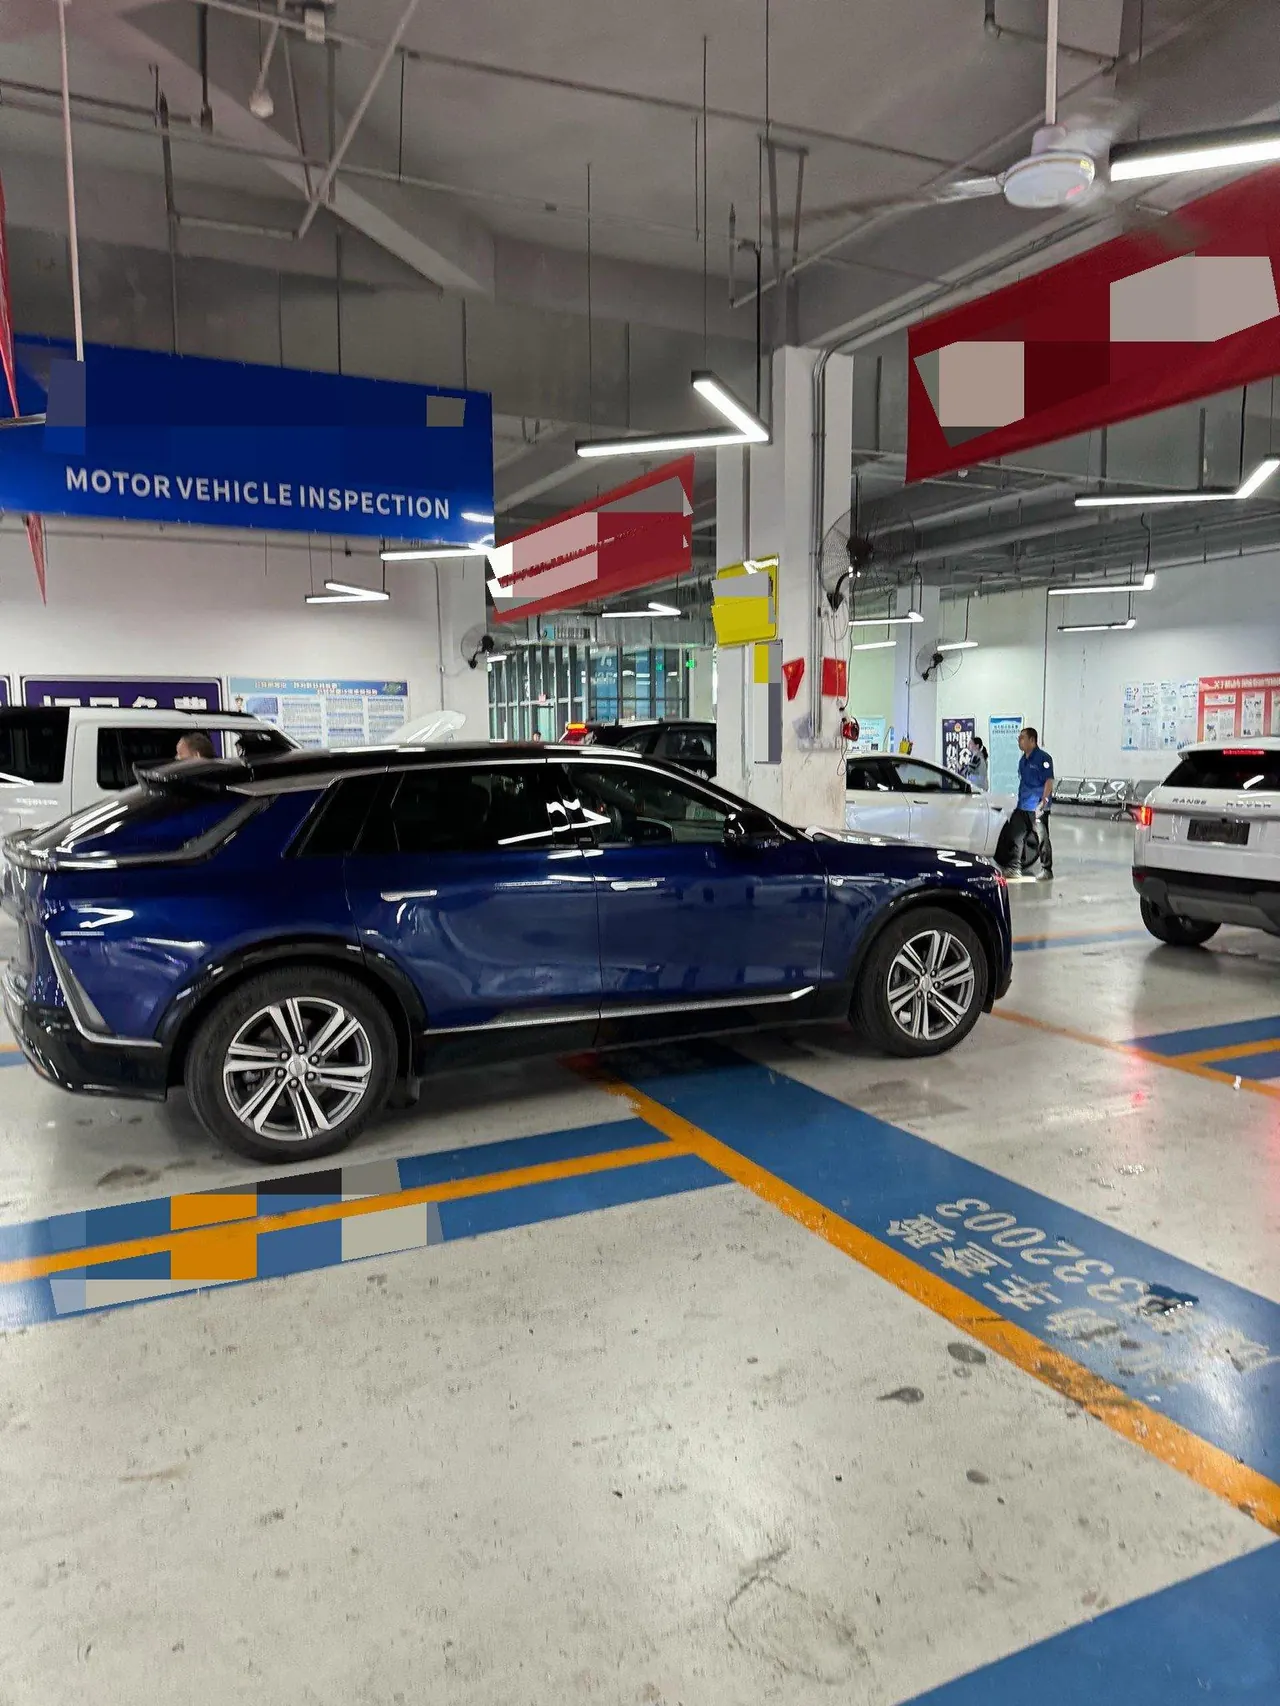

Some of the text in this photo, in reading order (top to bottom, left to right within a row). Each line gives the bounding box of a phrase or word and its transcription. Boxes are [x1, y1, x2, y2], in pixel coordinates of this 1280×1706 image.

[65, 465, 450, 520] MOTOR VEHICLE INSPECTION
